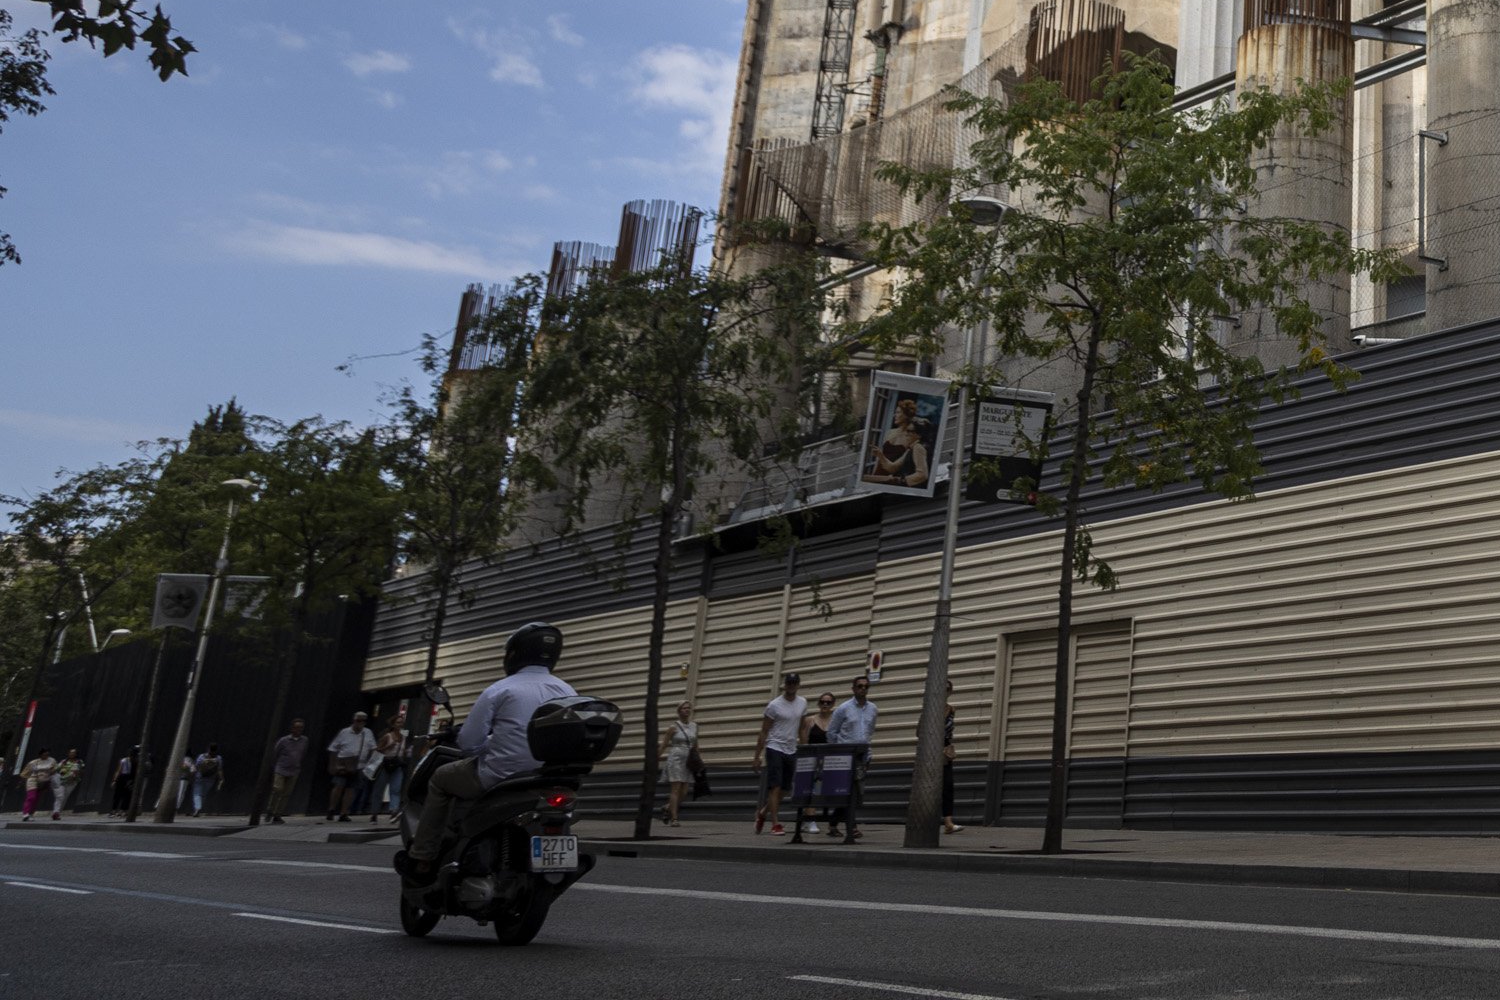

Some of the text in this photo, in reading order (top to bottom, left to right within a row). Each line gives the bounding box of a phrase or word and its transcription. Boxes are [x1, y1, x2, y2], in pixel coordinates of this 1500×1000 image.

[982, 406, 1033, 419] MARGUETE
[543, 838, 575, 851] 2710
[542, 851, 567, 866] HFF
